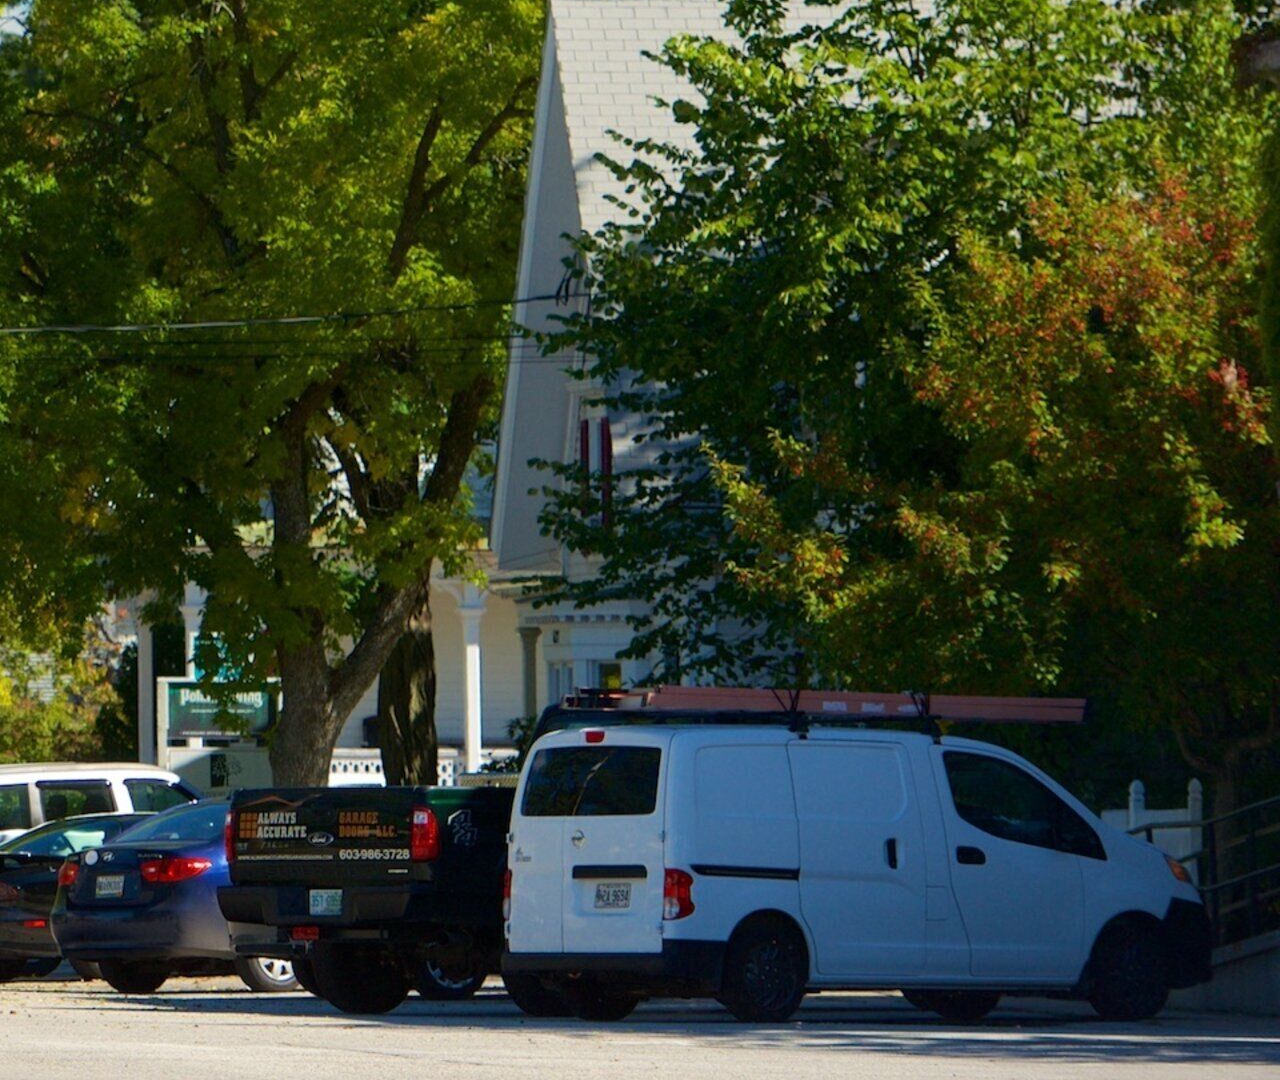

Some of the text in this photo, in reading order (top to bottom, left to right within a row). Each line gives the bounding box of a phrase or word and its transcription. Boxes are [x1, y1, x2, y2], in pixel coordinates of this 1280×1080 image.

[257, 811, 297, 824] ALWAYS
[339, 811, 379, 824] GARAGE
[256, 825, 308, 838] ACCURATE
[339, 848, 410, 860] 603-986-3728
